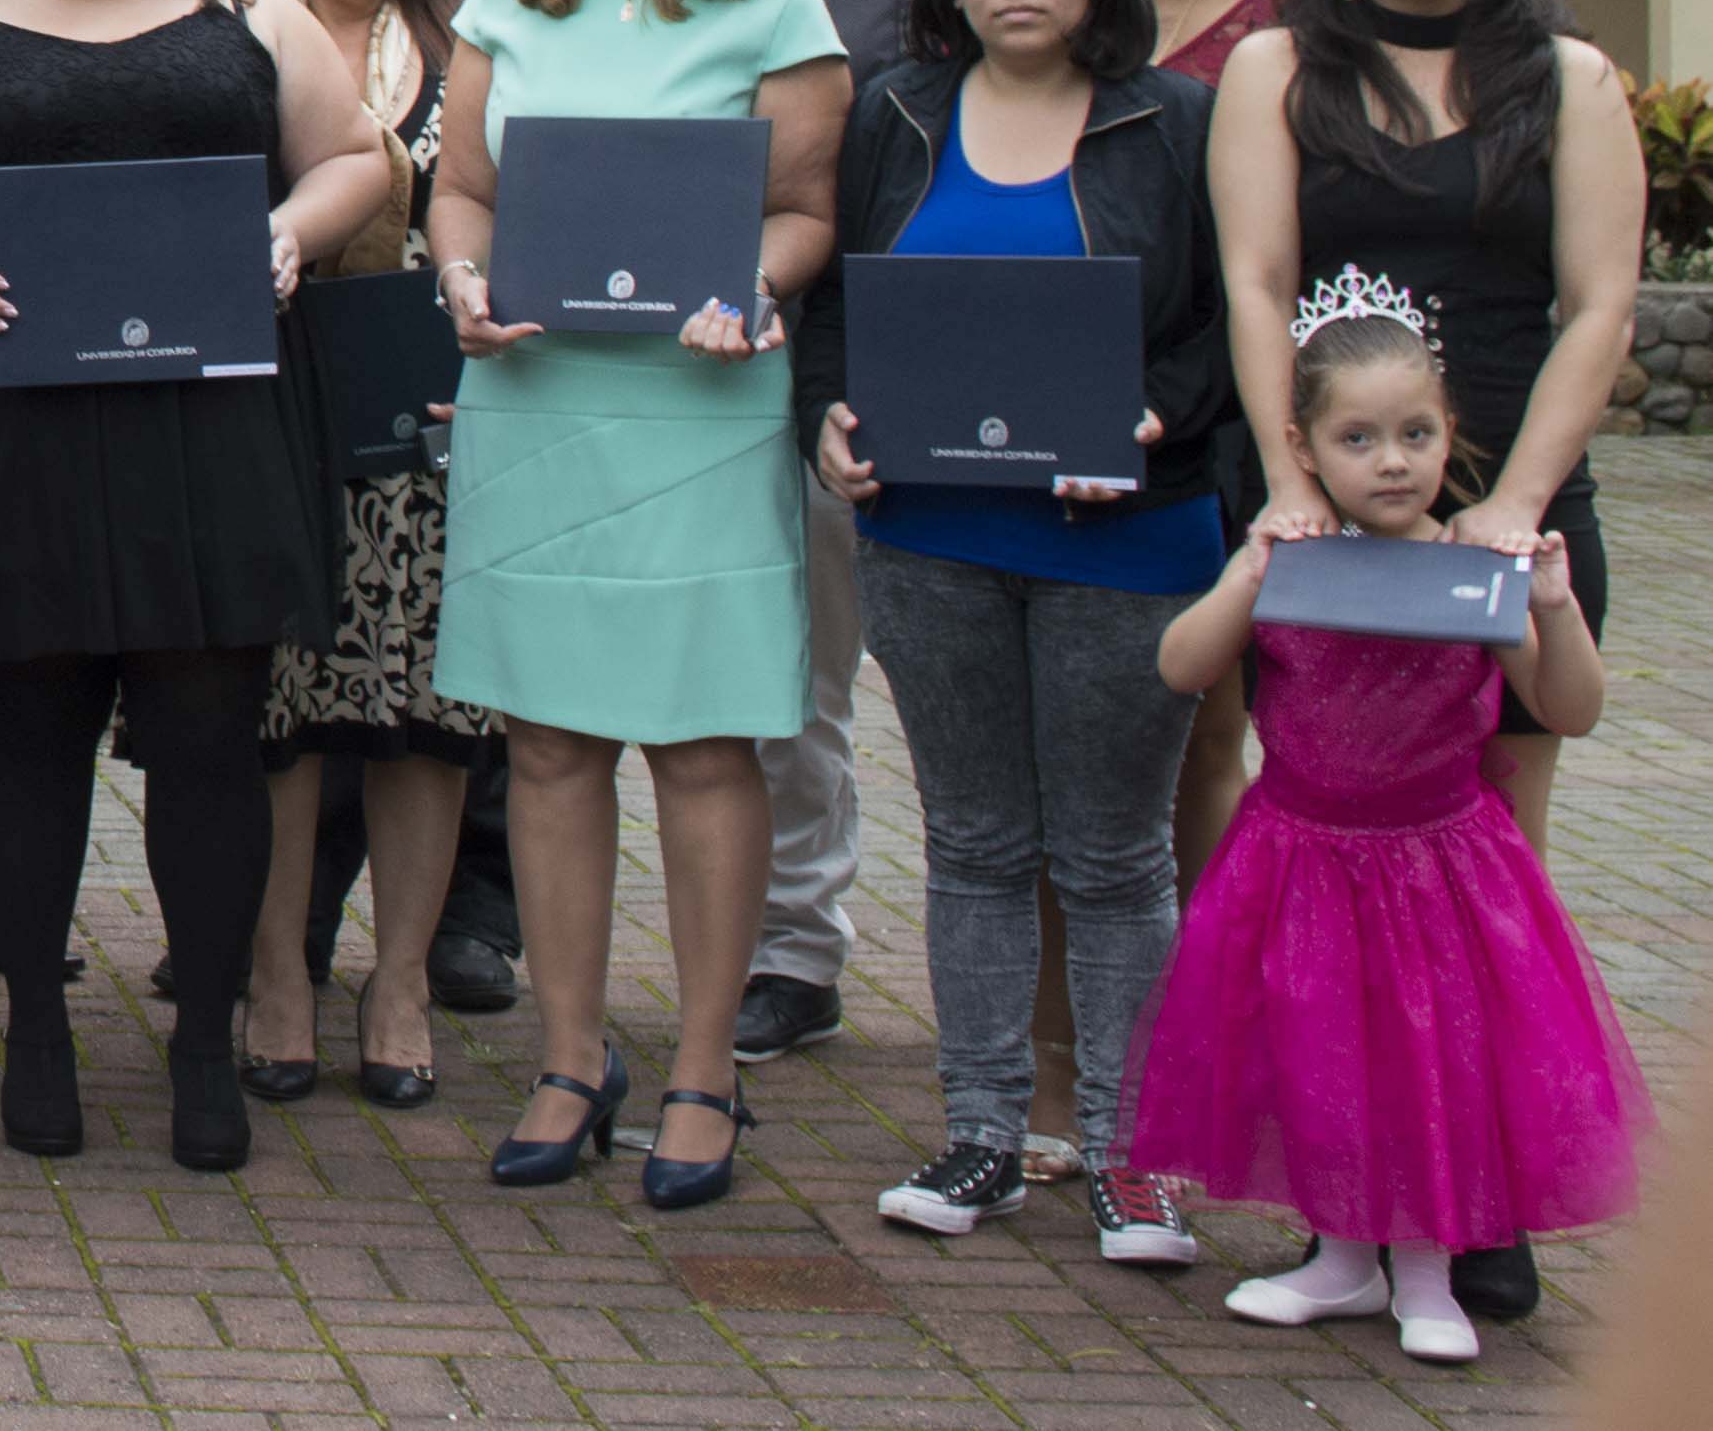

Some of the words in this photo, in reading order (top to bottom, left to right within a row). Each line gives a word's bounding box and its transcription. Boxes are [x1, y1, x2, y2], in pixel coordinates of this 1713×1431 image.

[563, 299, 616, 311] UNIVERSIDAD
[628, 301, 654, 311] COSTA
[654, 302, 677, 312] RICA
[76, 350, 135, 361] UNIVERSIDAD
[146, 347, 174, 358] COSTA
[174, 346, 197, 356] RICA
[930, 448, 991, 459] UNIVERSIDAD
[1004, 451, 1033, 461] COSTA
[1033, 451, 1058, 462] RICA
